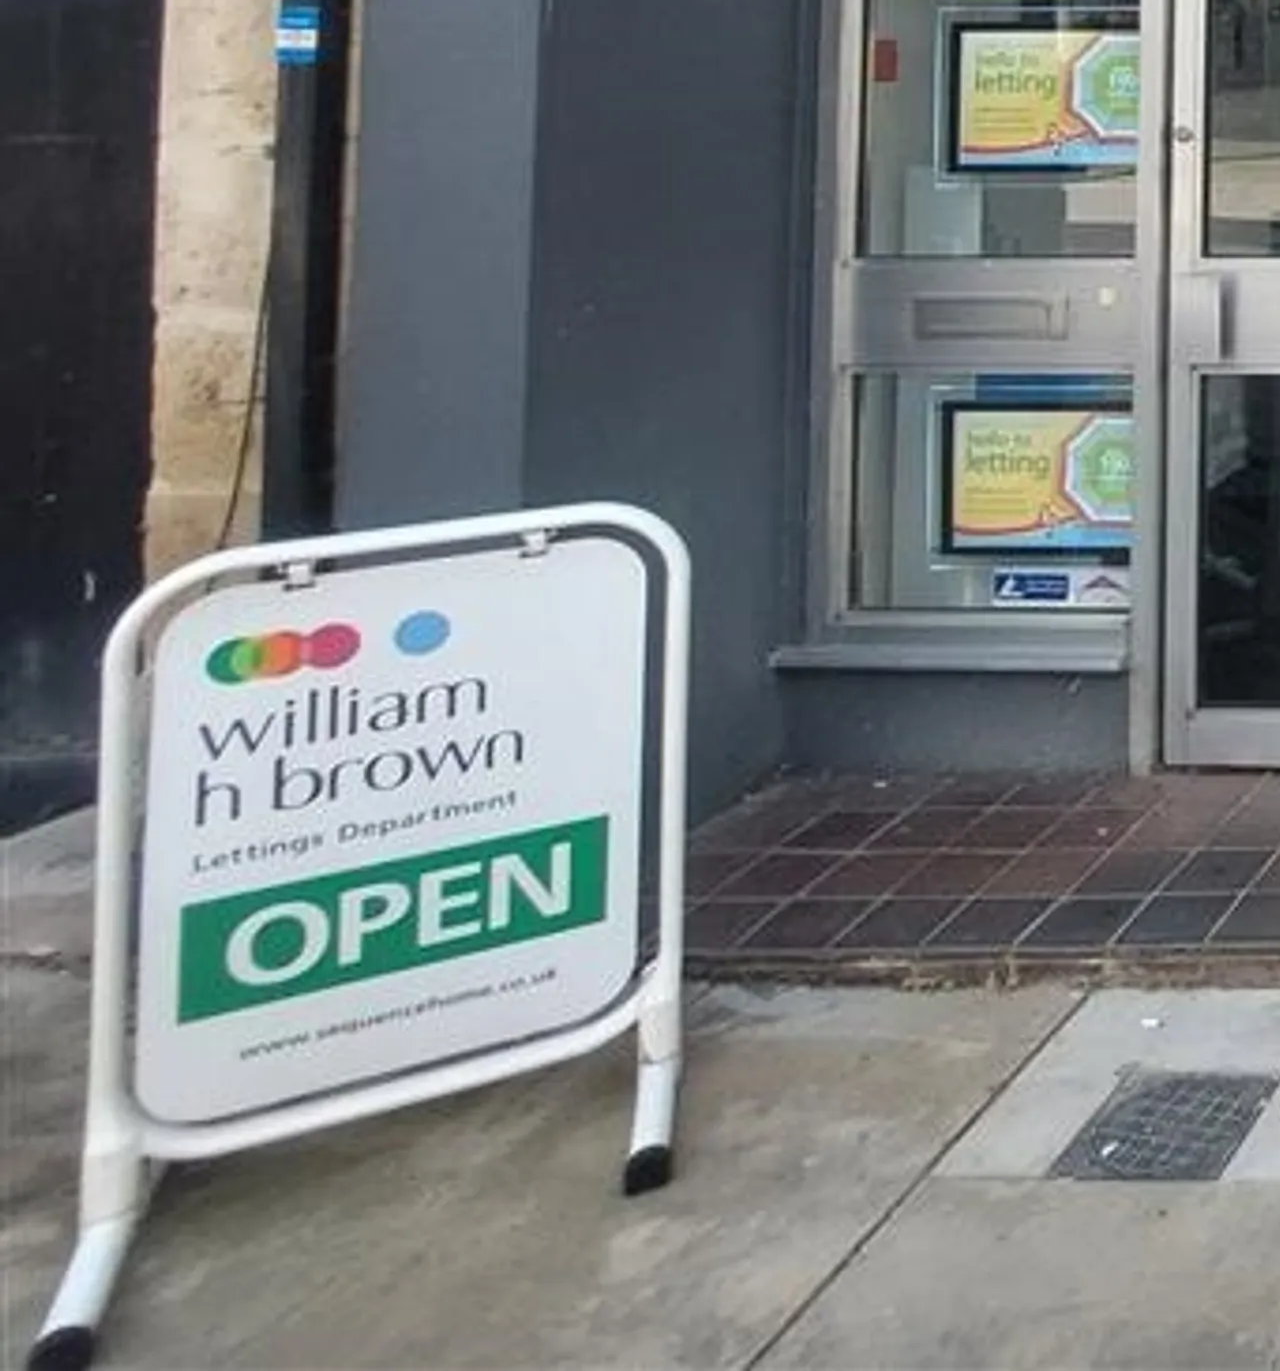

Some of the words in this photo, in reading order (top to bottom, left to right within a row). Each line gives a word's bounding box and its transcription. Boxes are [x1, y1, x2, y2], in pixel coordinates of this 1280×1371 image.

[975, 69, 1057, 102] letting
[965, 447, 1051, 480] letting
[199, 677, 487, 761] william
[194, 770, 241, 828] h
[272, 729, 525, 811] brown
[192, 832, 324, 873] Lettings
[337, 790, 518, 844] Department
[225, 841, 572, 988] OPEN
